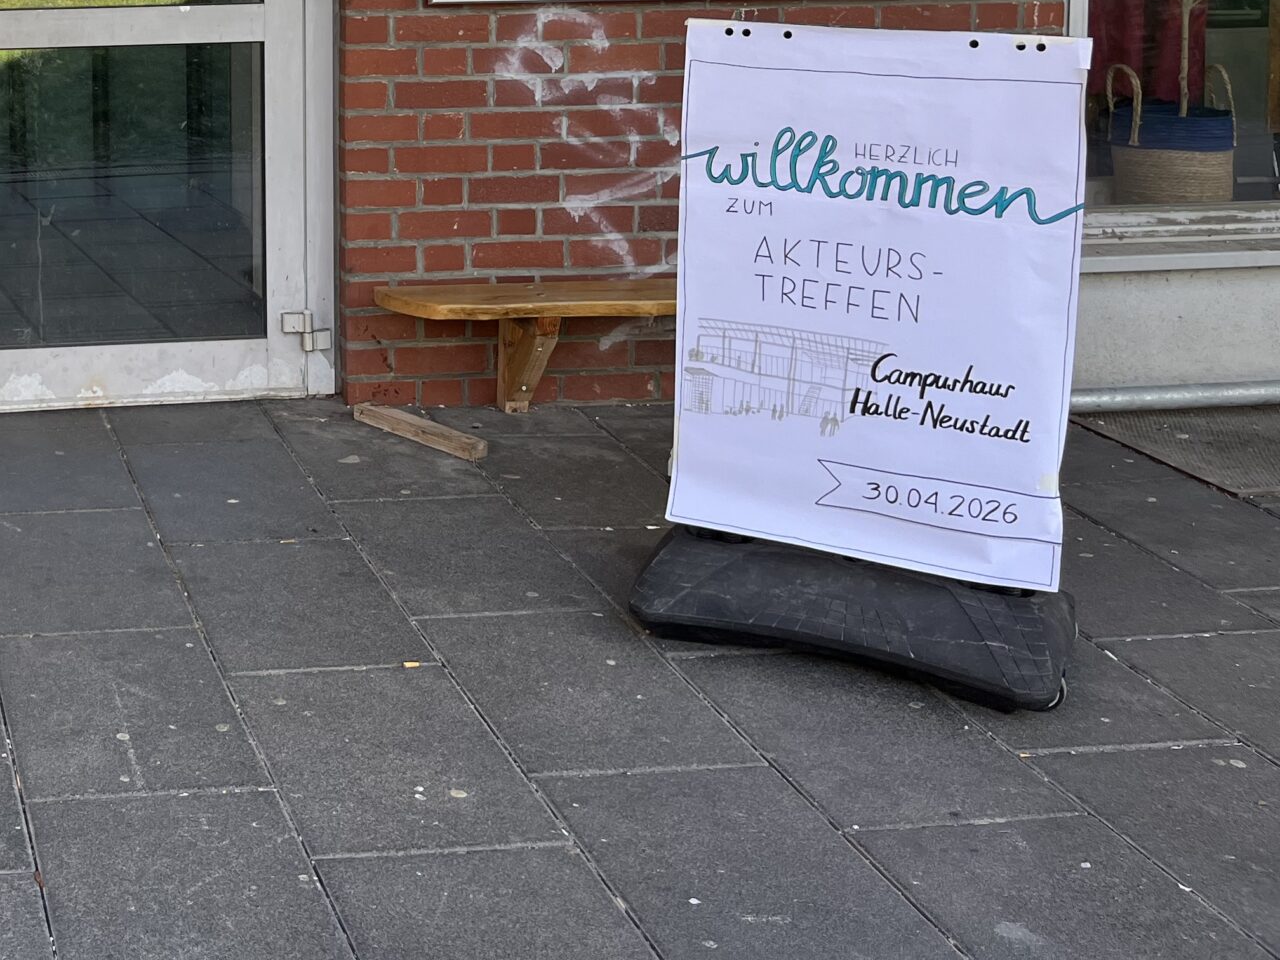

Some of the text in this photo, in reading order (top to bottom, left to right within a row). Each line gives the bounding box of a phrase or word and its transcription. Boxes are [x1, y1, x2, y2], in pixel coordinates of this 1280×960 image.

[681, 126, 1085, 225] willkommen
[724, 197, 774, 217] ZUM
[753, 235, 944, 281] AKTEURS-
[754, 273, 921, 324] TREFFEN
[869, 352, 1016, 400] Campushaus
[848, 387, 1032, 444] Halle-Neustadt
[862, 482, 1019, 526] 30.04.2026
